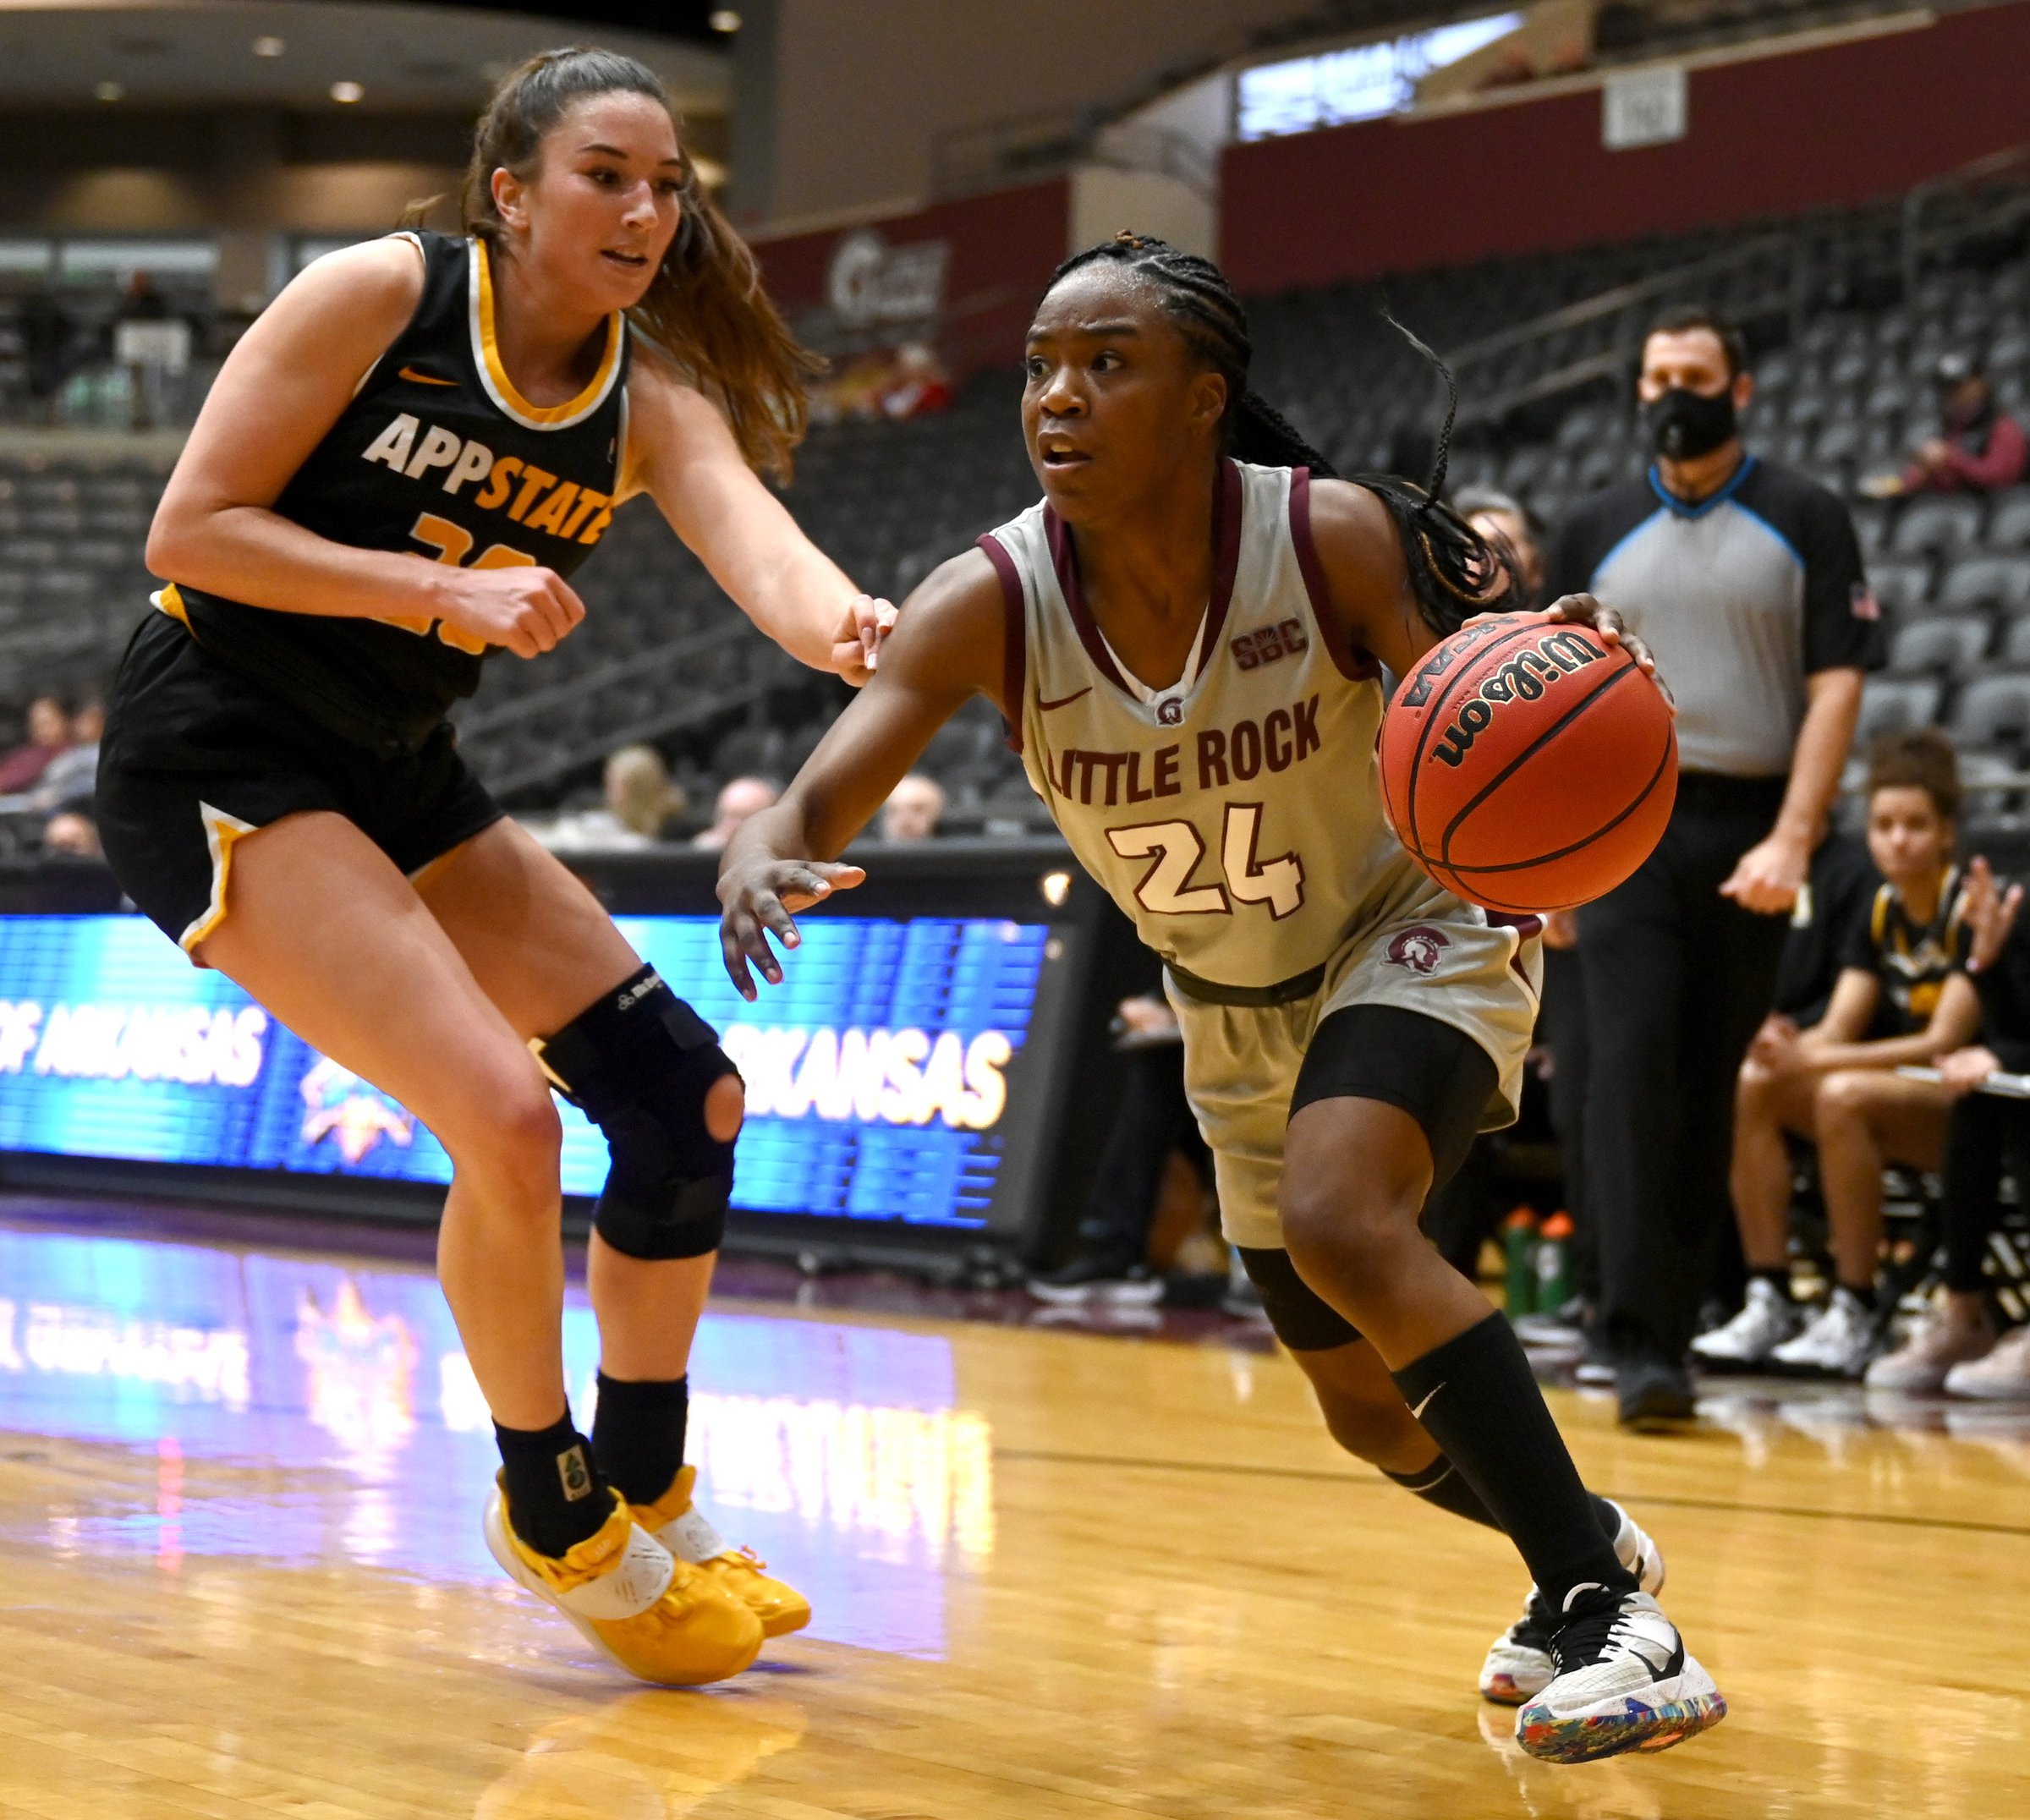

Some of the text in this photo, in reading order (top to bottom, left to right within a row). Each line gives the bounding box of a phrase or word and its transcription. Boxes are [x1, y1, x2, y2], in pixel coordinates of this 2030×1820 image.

[1231, 617, 1308, 672] SBC
[1401, 616, 1522, 708] NCAA
[1046, 692, 1321, 806] LITTLE ROCK
[1432, 630, 1610, 770] Wilson
[1104, 801, 1306, 922] 24
[34, 1003, 267, 1087] ARKANSAS
[721, 1022, 1012, 1130] RKANSAS
